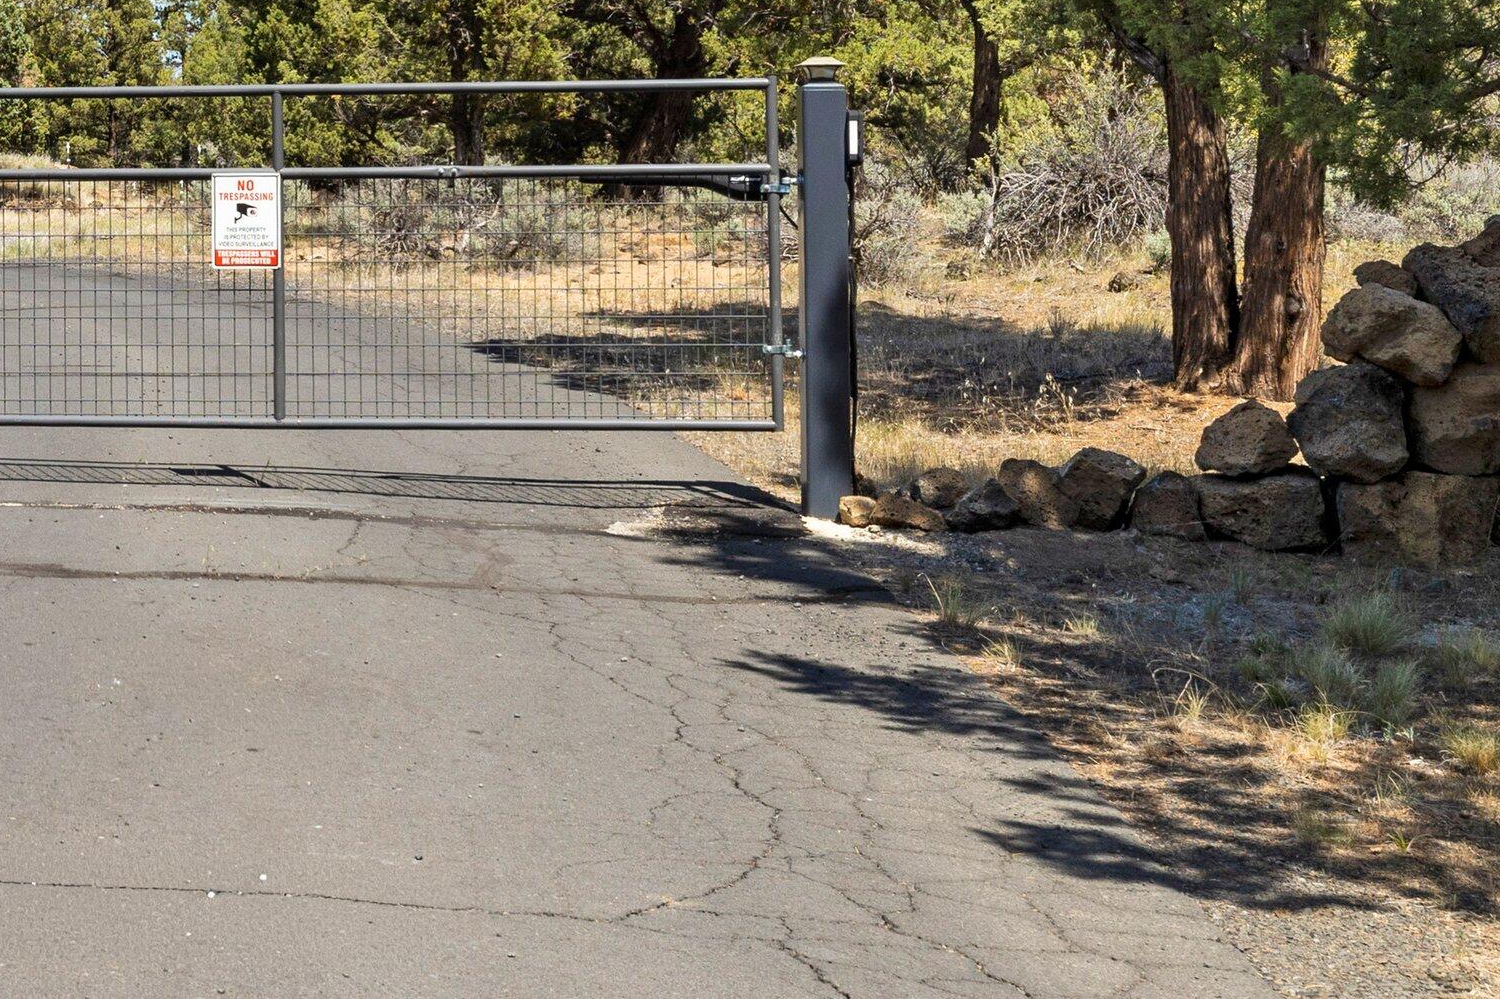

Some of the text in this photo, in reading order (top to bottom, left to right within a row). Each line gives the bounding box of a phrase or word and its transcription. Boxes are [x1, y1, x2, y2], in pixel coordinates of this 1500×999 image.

[237, 180, 254, 191] NO
[219, 193, 274, 201] TRESPASSING
[221, 257, 271, 265] BE PROSECUTED
